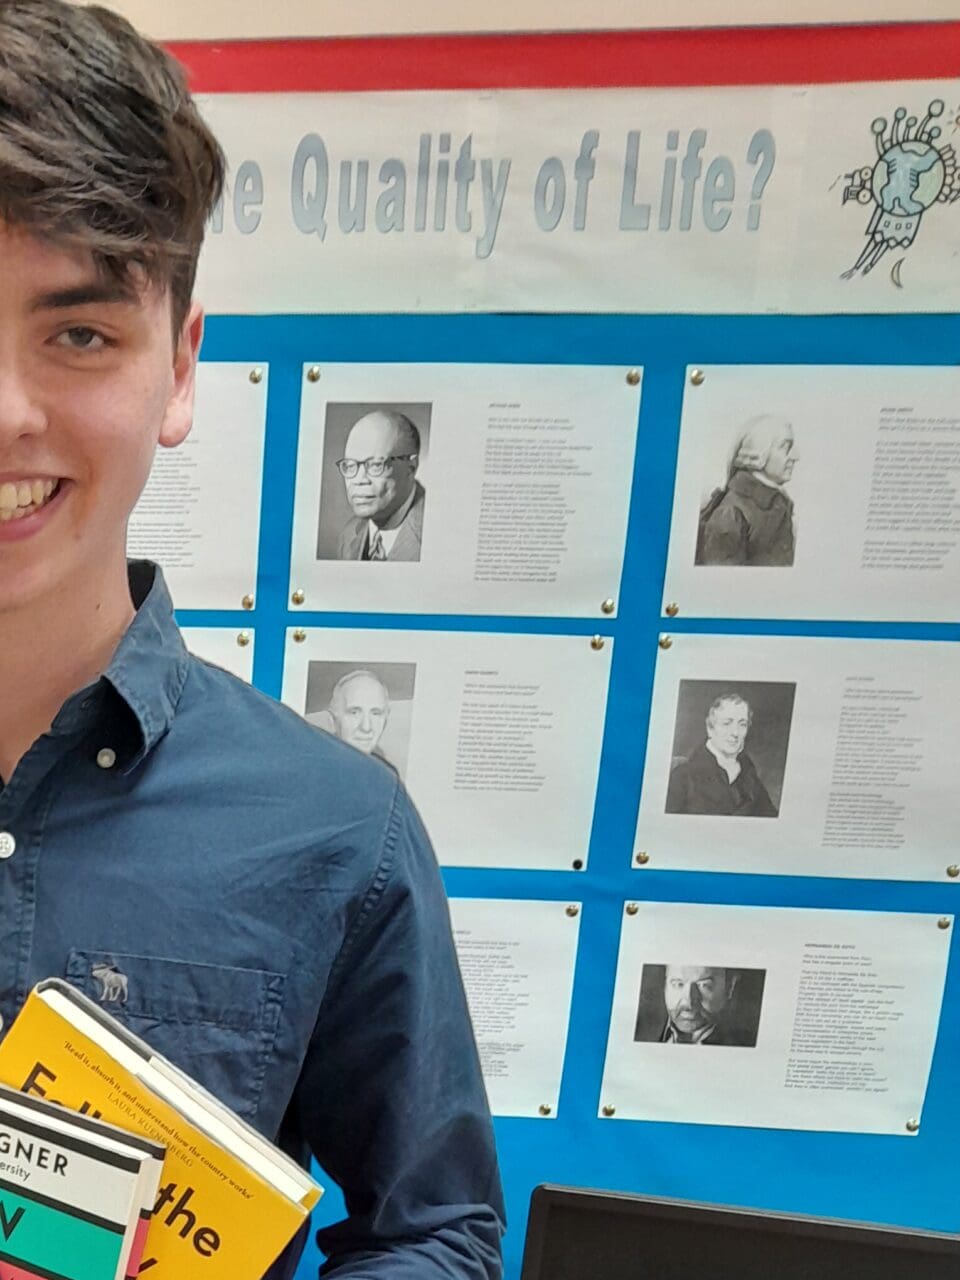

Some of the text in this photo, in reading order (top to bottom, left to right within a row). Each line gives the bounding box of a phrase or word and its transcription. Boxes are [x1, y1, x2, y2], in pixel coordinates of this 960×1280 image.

[290, 131, 512, 259] Quality
[533, 129, 601, 233] of
[618, 127, 777, 233] Life?
[135, 1101, 175, 1136] understand
[173, 1131, 189, 1147] how
[188, 1145, 202, 1158] the
[201, 1155, 229, 1181] country
[152, 1183, 221, 1257] the
